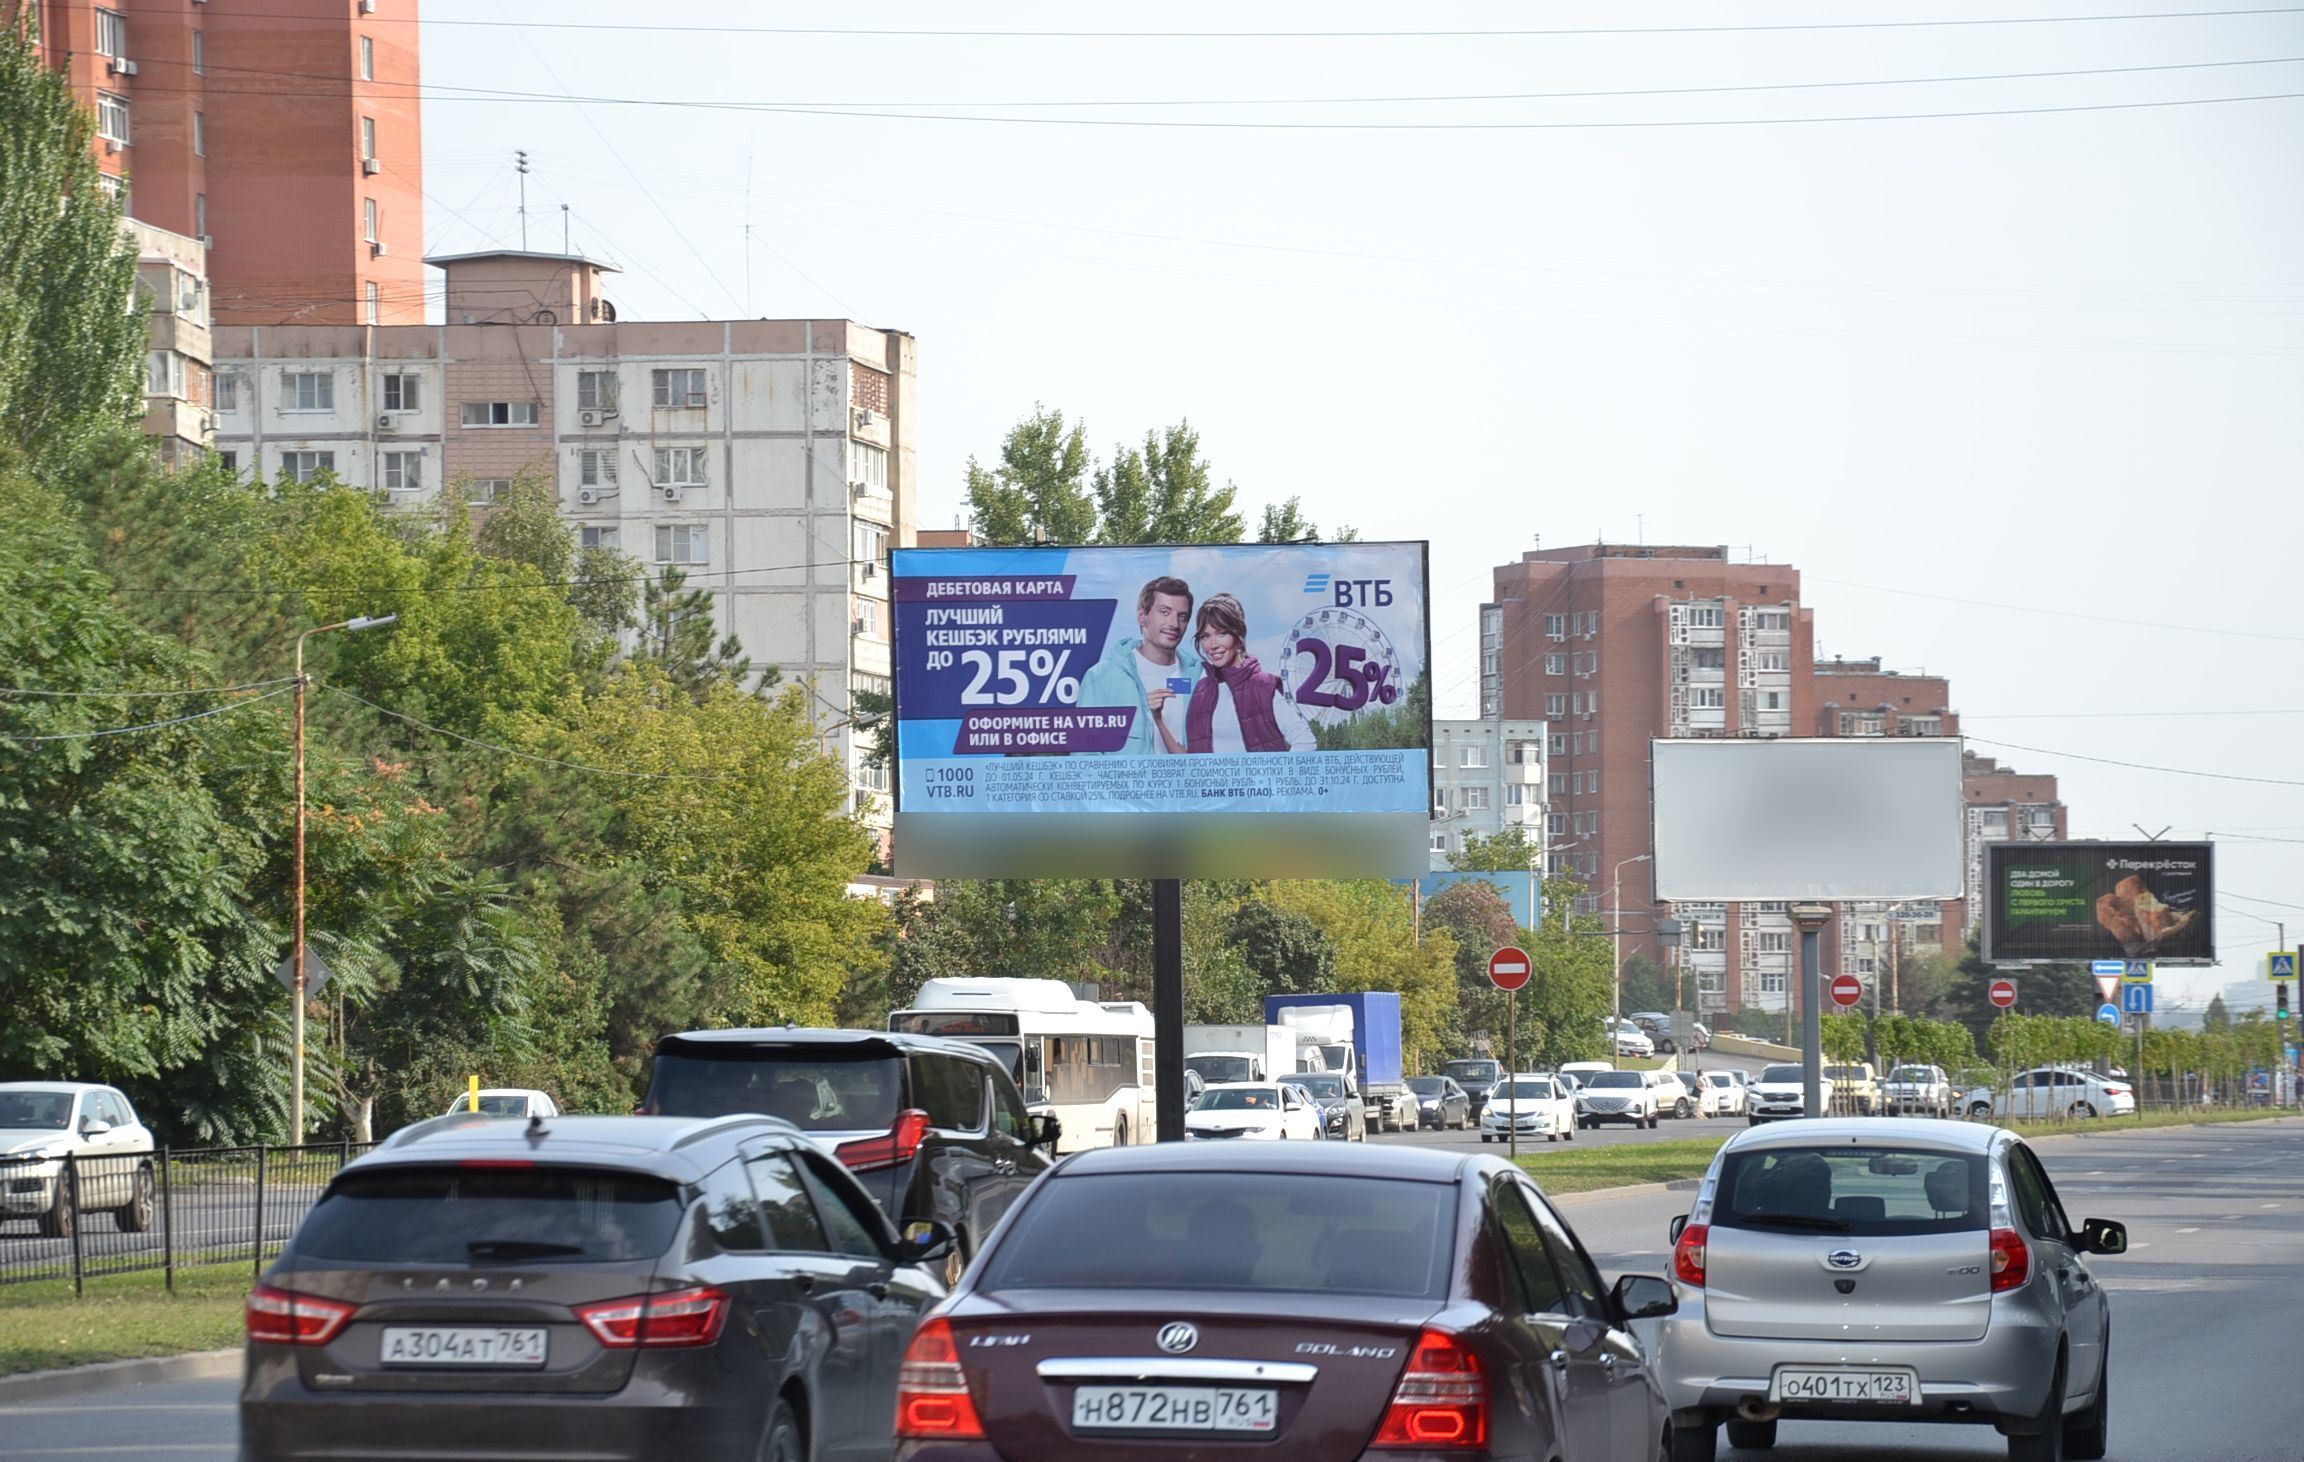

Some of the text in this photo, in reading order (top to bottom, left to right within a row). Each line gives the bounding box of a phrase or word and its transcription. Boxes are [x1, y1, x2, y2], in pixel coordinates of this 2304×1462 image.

[926, 581, 1064, 598] ДЕБЕТОВАЯ КАРТА
[1335, 579, 1393, 607] ВТБ
[925, 605, 1003, 626] ЛУЧШИЙ
[926, 628, 1087, 647] КЕШБЭК РУБЛЯМИ
[926, 649, 1080, 705] ДО 25%
[1295, 637, 1397, 711] 25%
[969, 715, 1127, 731] ОФОРМИТЕ НА VTB.RU
[969, 732, 1067, 746] ИЛИ В ОФИСЕ
[985, 760, 1024, 772] «ЛУЧШИЙ
[1026, 761, 1063, 771] КЕШБЭК»
[1065, 761, 1077, 770] ПО
[1079, 759, 1127, 770] СРАВНЕНИЮ
[1129, 759, 1136, 769] С
[1137, 758, 1187, 769] УСЛОВИЯМИ
[1189, 757, 1240, 768] ПРОГРАММЫ
[1241, 756, 1293, 767] ЛОЯЛЬНОСТИ
[1295, 755, 1322, 765] БАНКА
[1344, 752, 1404, 765] ДЕЙСТВУЮЩЕЙ
[937, 768, 974, 782] 1000
[985, 772, 997, 783] ДО
[1001, 772, 1034, 782] 01.05.24
[1050, 771, 1082, 781] КЕШБЭК
[1097, 769, 1147, 780] ЧАСТИЧНЫЙ
[1152, 769, 1186, 779] ВОЗВРАТ
[1190, 768, 1241, 778] СТОИМОСТИ
[1245, 767, 1284, 777] ПОКУПКИ
[1288, 767, 1294, 776] В
[1299, 766, 1320, 776] ВИДЕ
[1325, 765, 1369, 775] БОНУСНЫХ
[926, 785, 974, 798] VTB.RU
[985, 782, 1054, 792] АВТОМАТИЧЕСКИ
[1056, 780, 1129, 791] КОНВЕРТИРУЕМЫХ
[1132, 780, 1144, 790] ПО
[1147, 780, 1172, 790] КУРСУ
[1184, 777, 1228, 788] БОНУСНЫЙ
[1231, 777, 1256, 788] РУБЛЬ
[1304, 776, 1317, 786] ДО
[1362, 774, 1405, 786] ДОСТУПНА
[992, 792, 1037, 802] КАТЕГОРИЯ
[1038, 792, 1049, 801] СО
[1051, 790, 1087, 801] СТАВКОЙ
[1109, 790, 1155, 801] ПОДРОБНЕЕ
[1156, 790, 1168, 799] НА
[1201, 788, 1226, 798] БАНК
[1228, 788, 1245, 798] ВТБ
[1247, 787, 1275, 799] (ПАО).
[1318, 786, 1329, 796] 0+
[2120, 859, 2196, 871] Перекрёсток
[2028, 869, 2060, 879] ДОМОЙ
